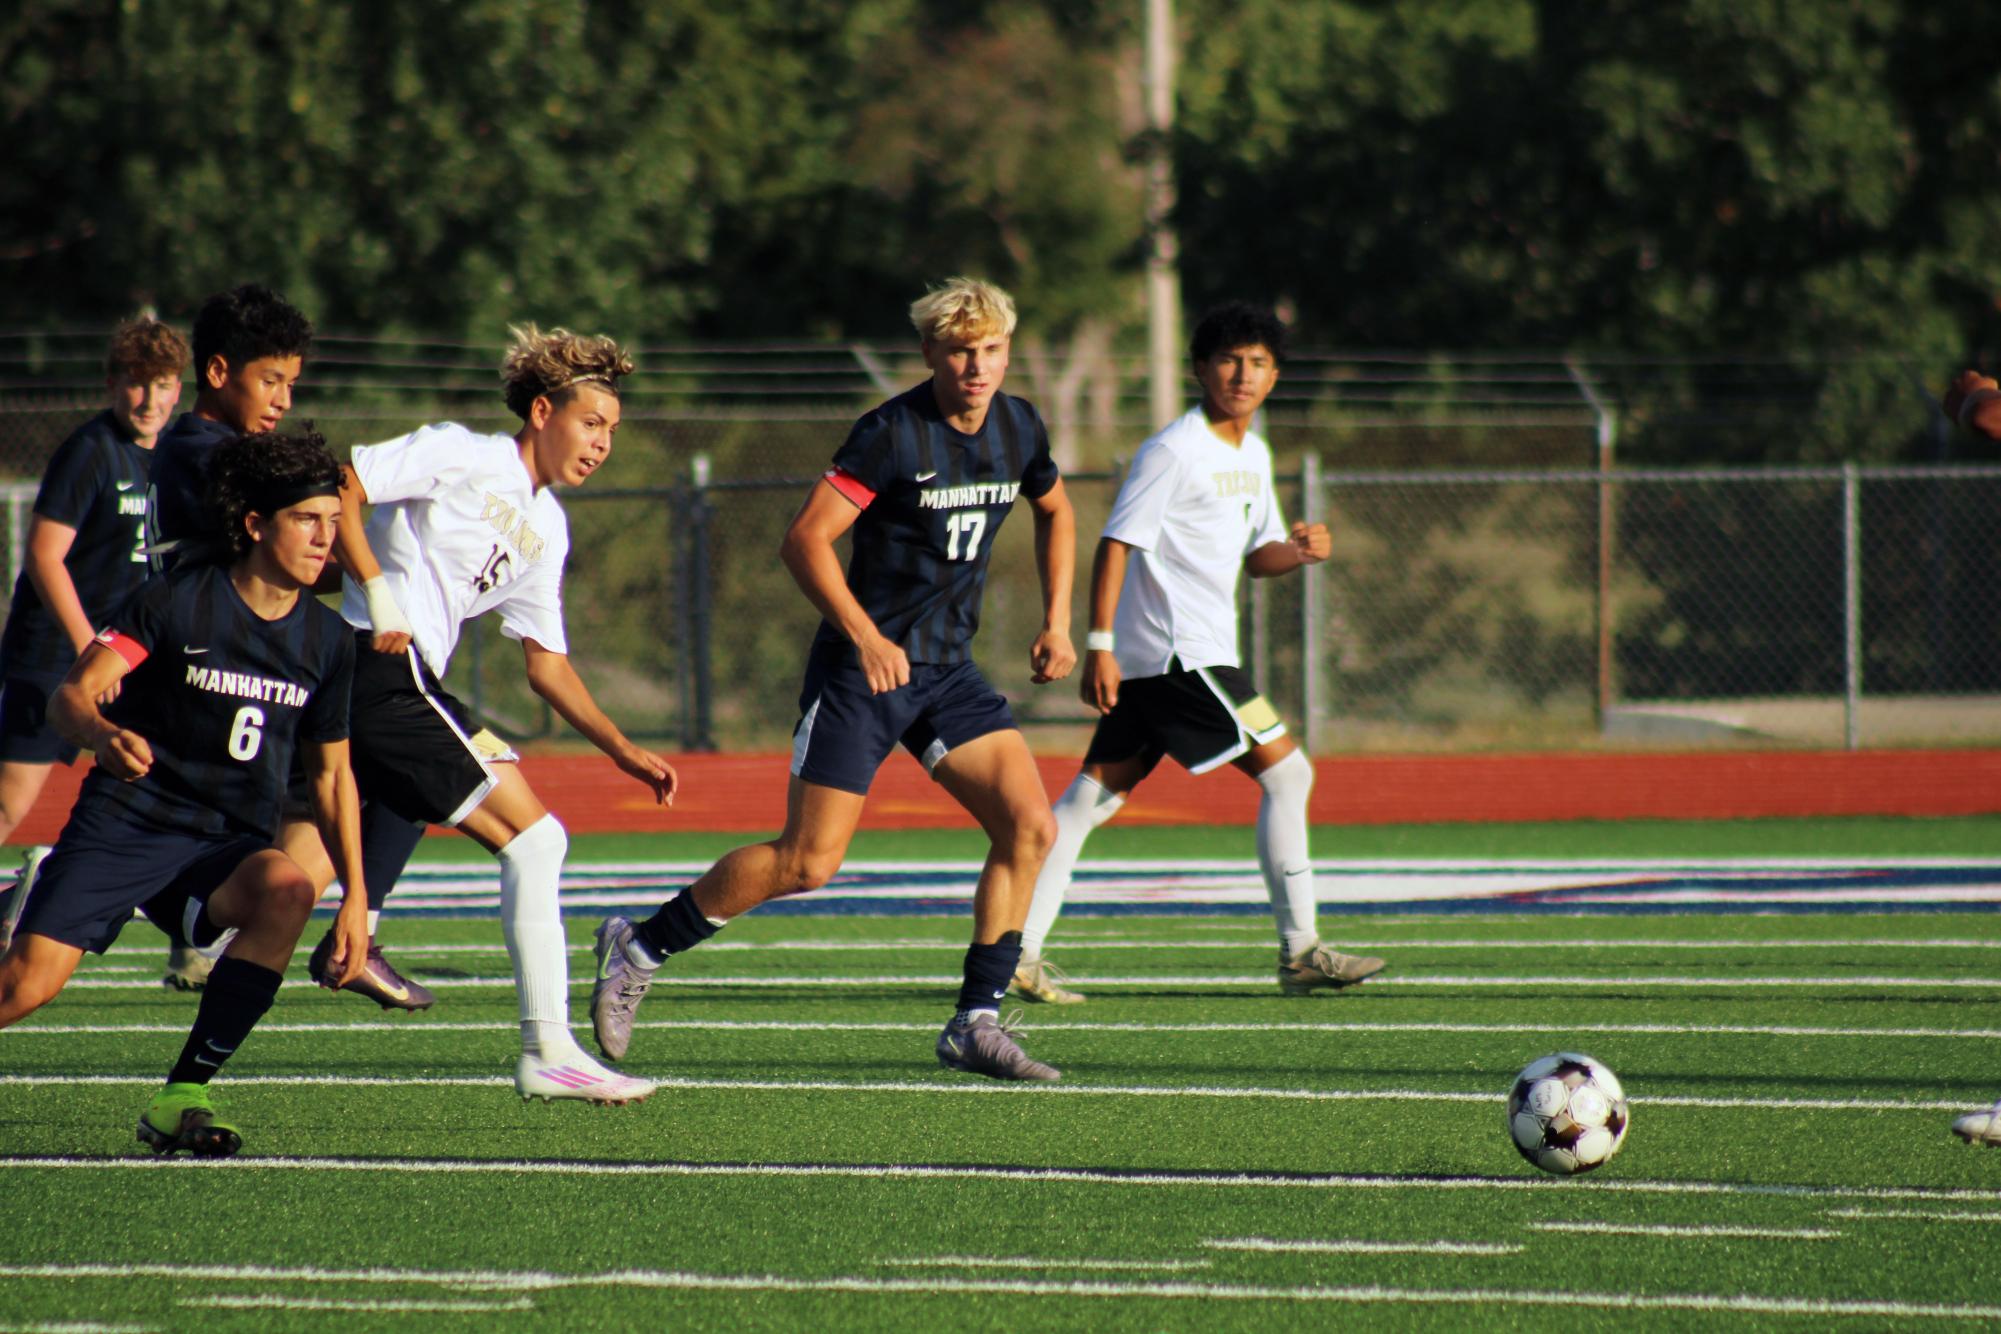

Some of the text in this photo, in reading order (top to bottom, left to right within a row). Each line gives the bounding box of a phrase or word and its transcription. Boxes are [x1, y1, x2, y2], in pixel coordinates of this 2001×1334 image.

[947, 511, 986, 561] 17
[185, 664, 309, 707] MANHATTAN
[228, 706, 265, 762] 6
